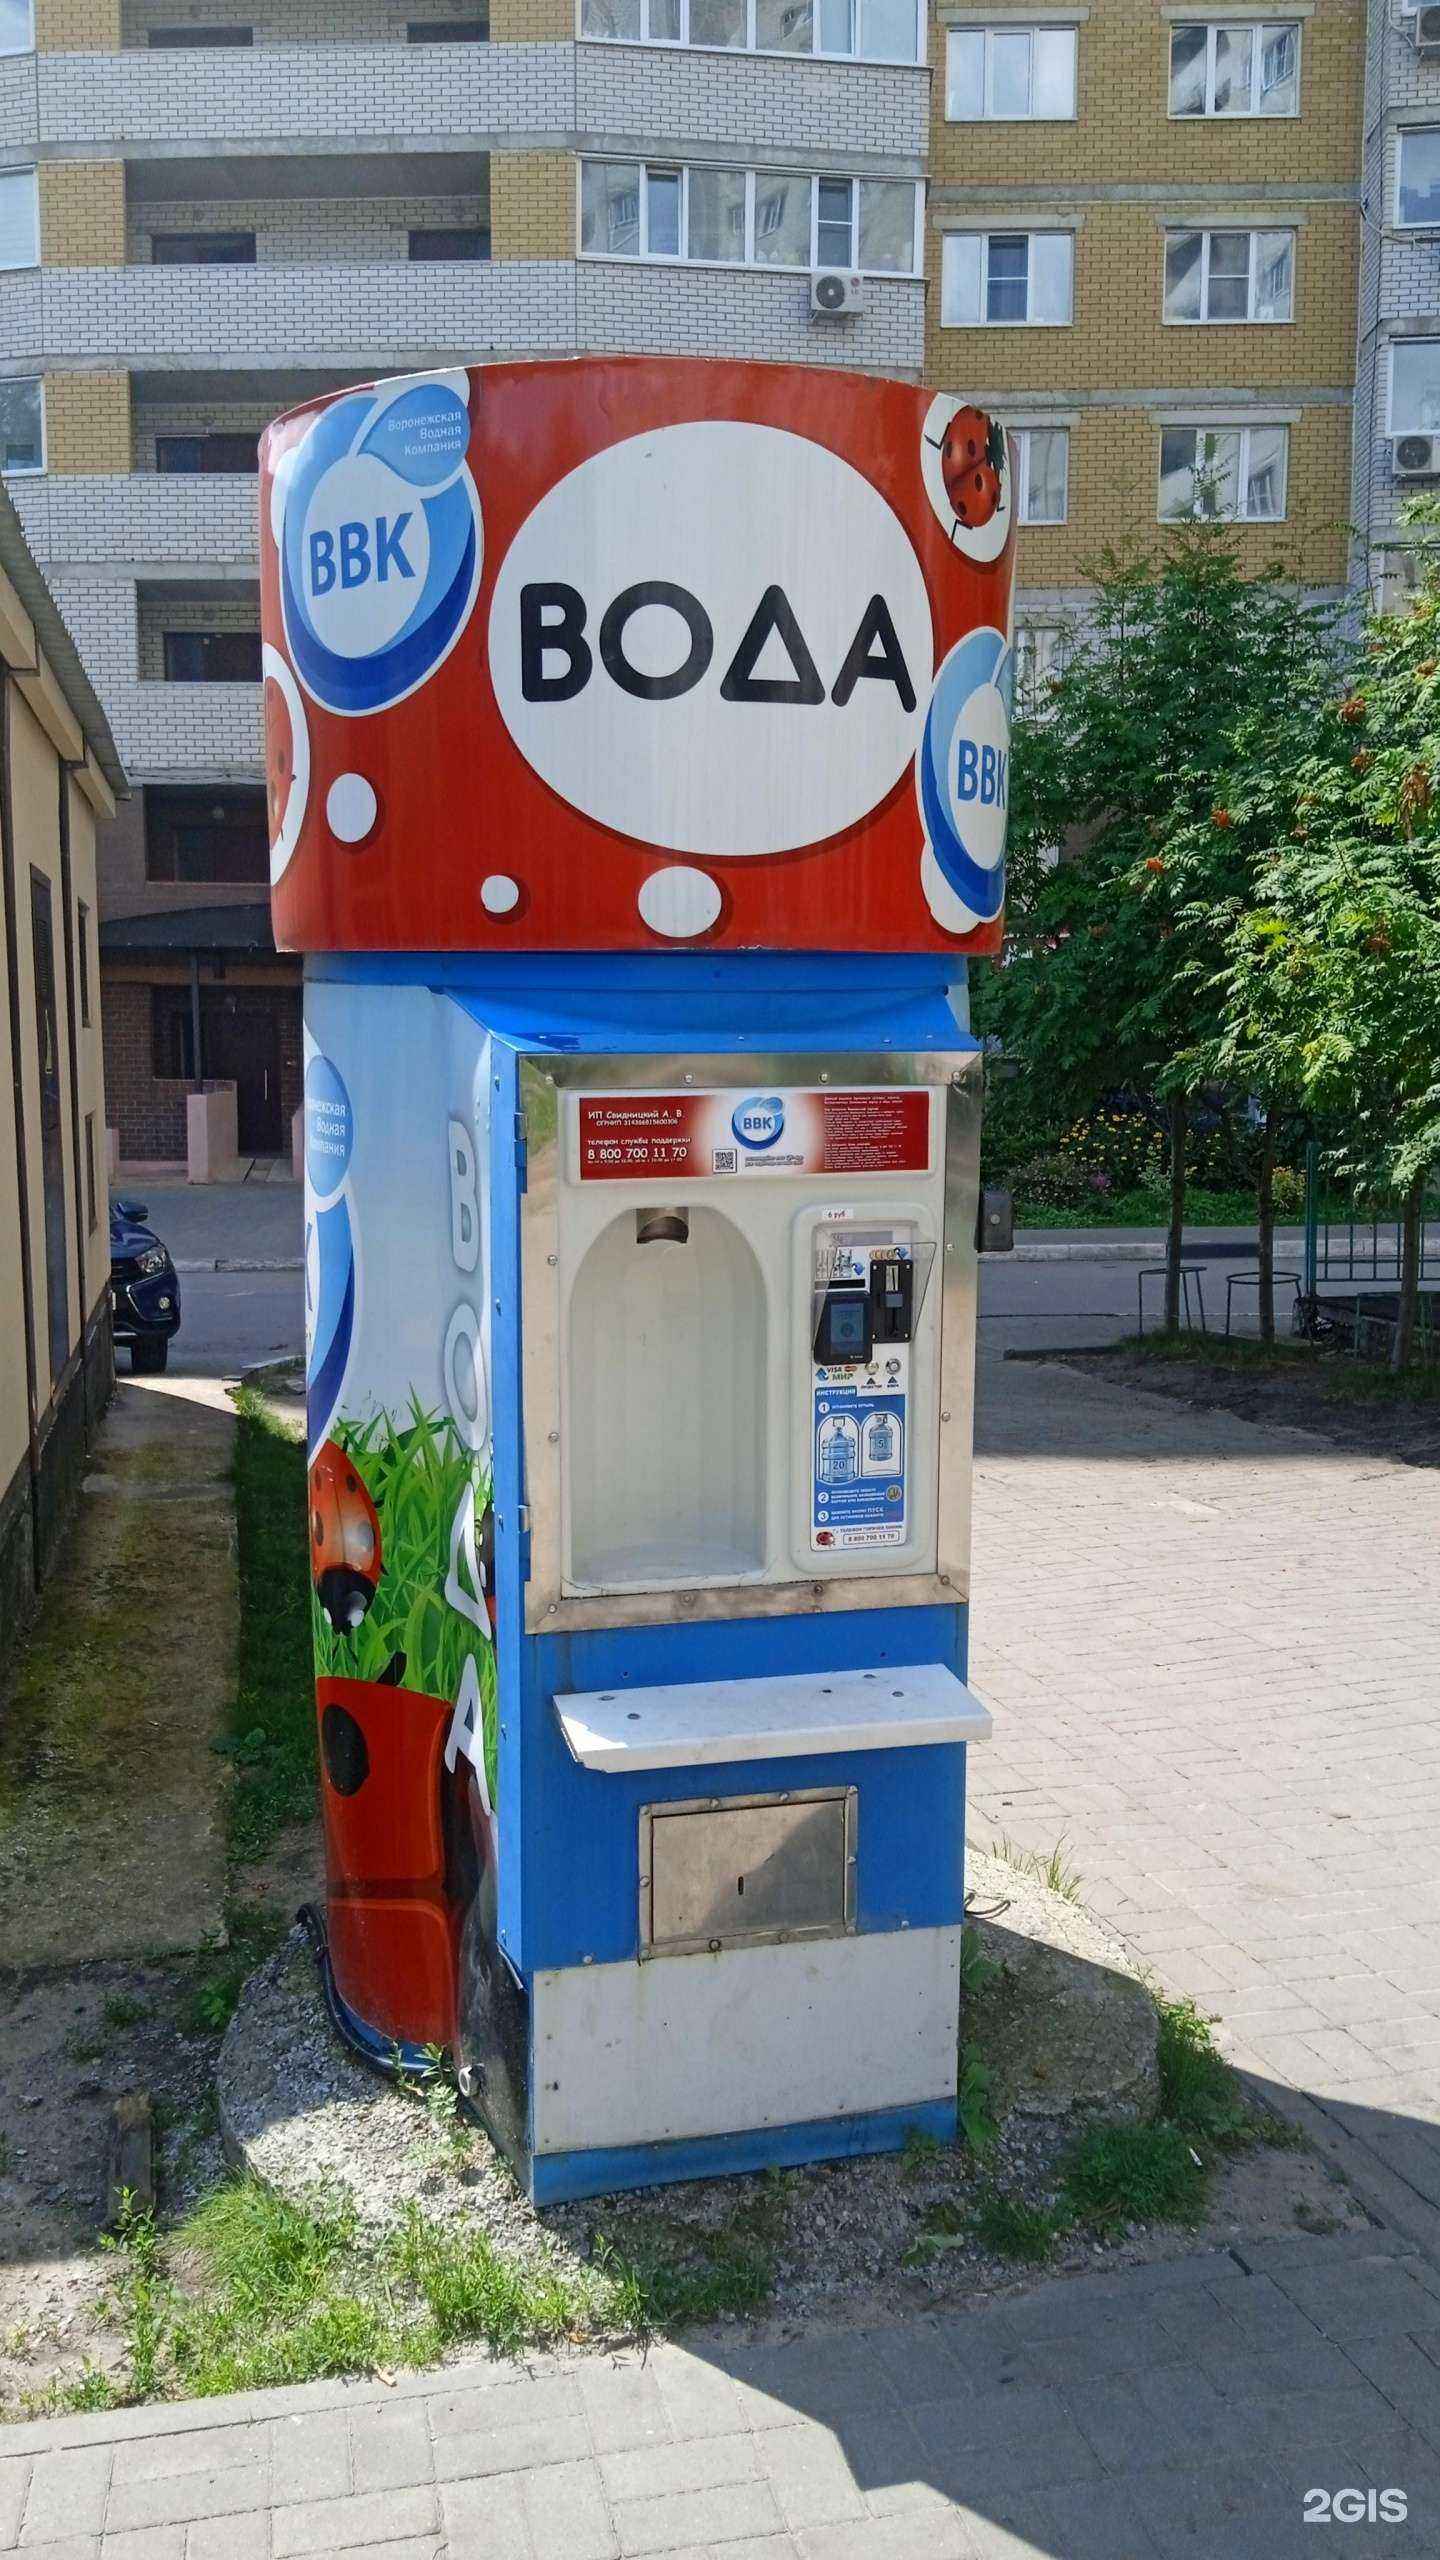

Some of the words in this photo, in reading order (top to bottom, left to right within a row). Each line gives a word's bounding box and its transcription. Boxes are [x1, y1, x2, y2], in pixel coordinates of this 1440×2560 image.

[388, 411, 461, 431] Воронежская
[420, 426, 461, 439] Водная
[404, 440, 461, 456] Компания
[310, 512, 416, 597] ВВК
[520, 580, 917, 714] ВОДА
[588, 1111, 603, 1120] ИП
[743, 1117, 772, 1130] ВВК
[587, 1138, 619, 1147] телефон
[620, 1137, 648, 1146] службы
[651, 1137, 691, 1146] поддержки
[588, 1149, 595, 1159] 8
[600, 1148, 622, 1159] 800
[626, 1148, 648, 1158] 700
[654, 1147, 666, 1157] 11
[672, 1147, 688, 1157] 70
[833, 1461, 845, 1470] 20
